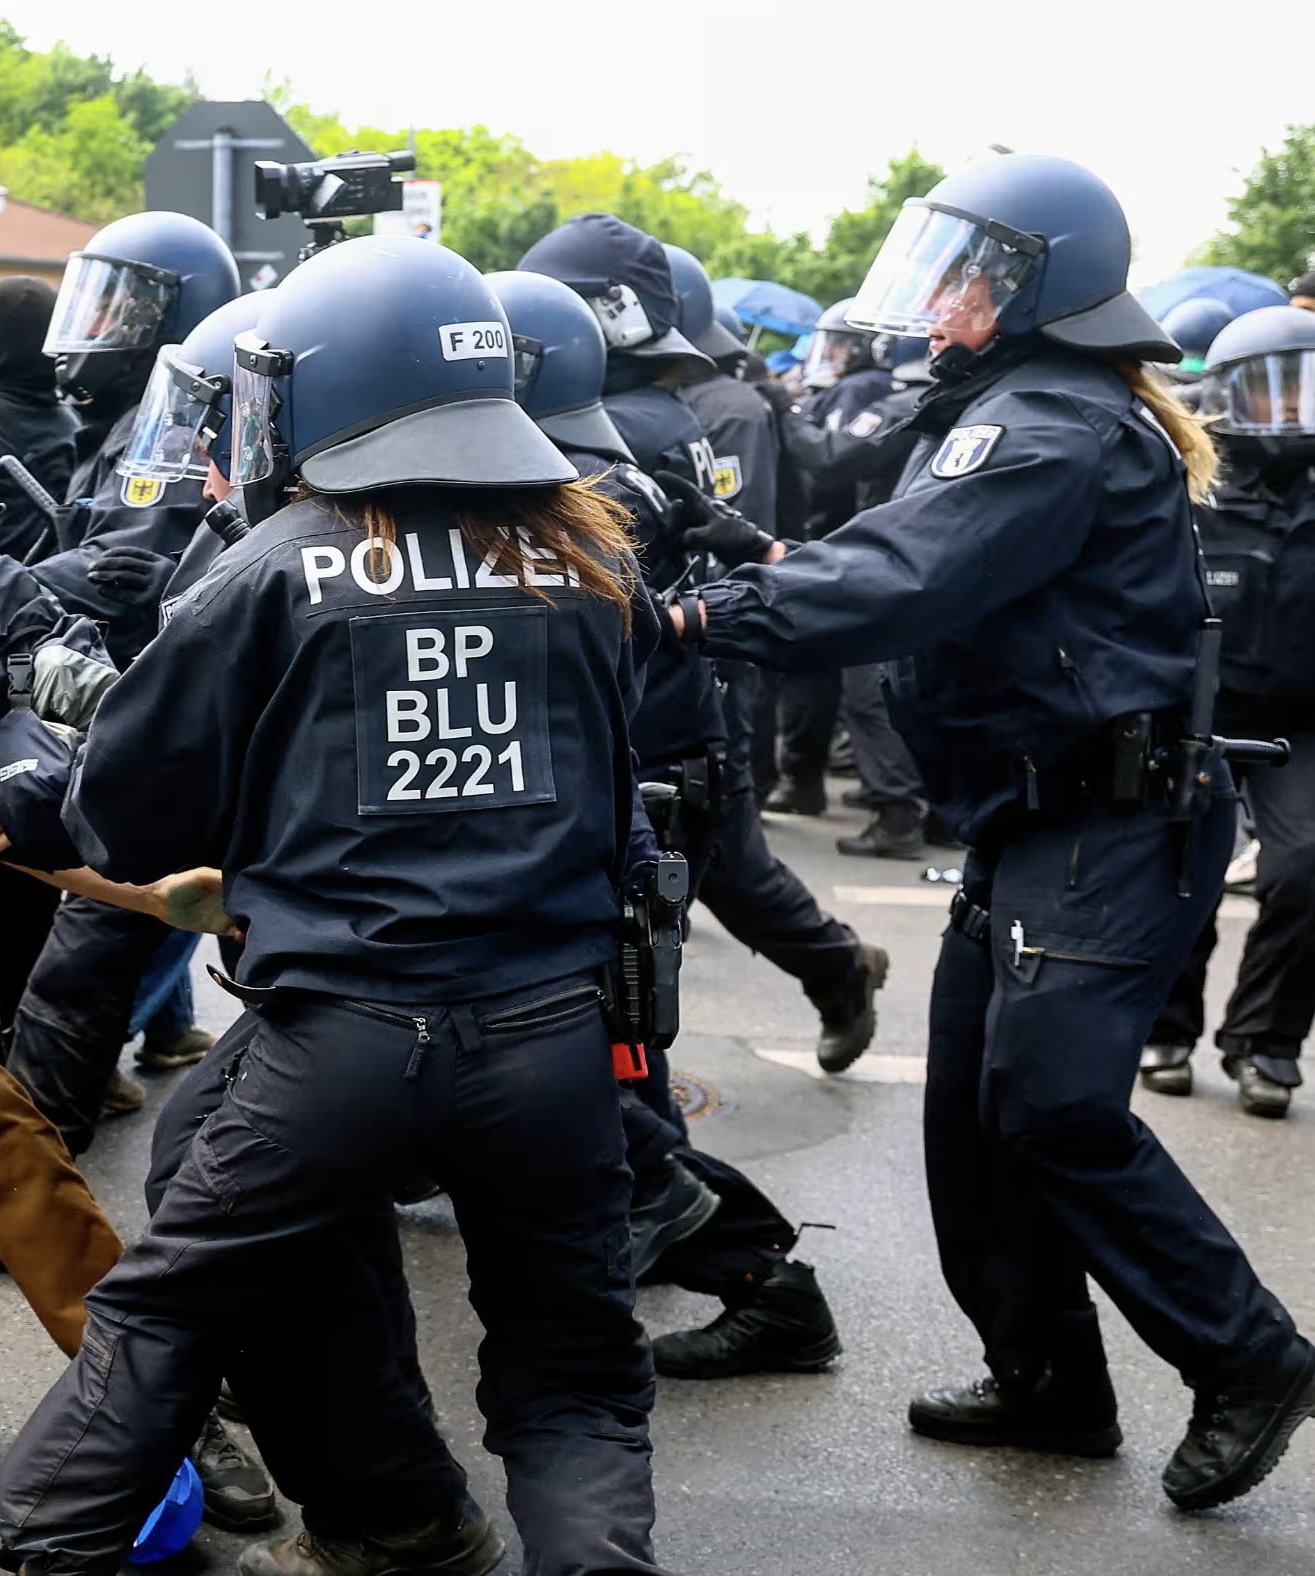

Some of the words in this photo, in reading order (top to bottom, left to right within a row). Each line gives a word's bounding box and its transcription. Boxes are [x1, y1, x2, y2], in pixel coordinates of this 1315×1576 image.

[450, 331, 464, 352] F
[472, 329, 503, 350] 200
[406, 625, 494, 682] BP
[386, 681, 517, 742] BLU
[387, 740, 525, 801] 2221
